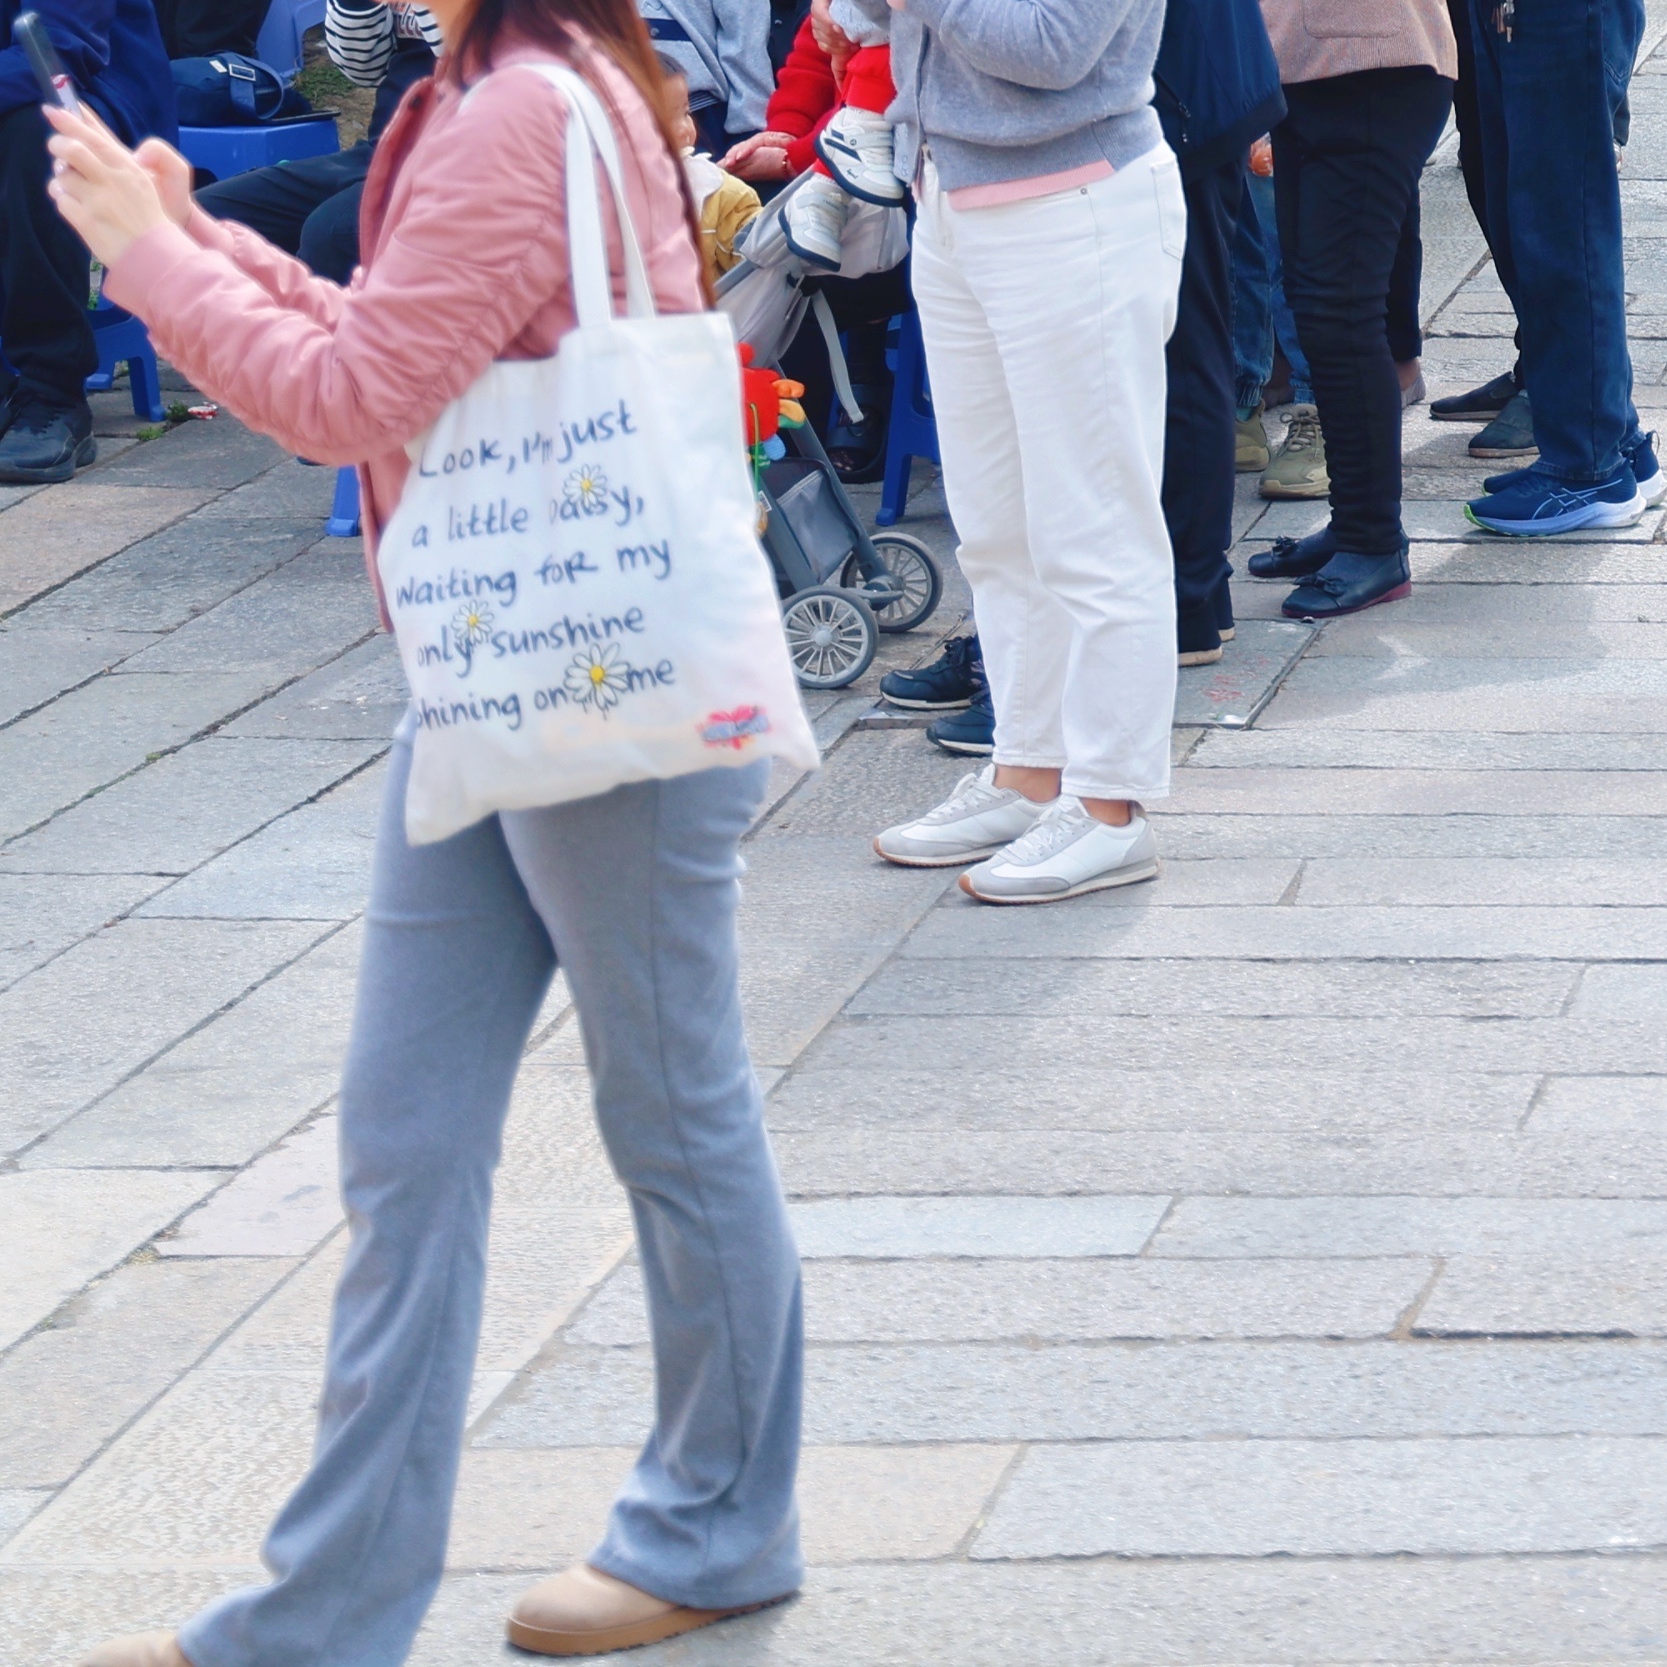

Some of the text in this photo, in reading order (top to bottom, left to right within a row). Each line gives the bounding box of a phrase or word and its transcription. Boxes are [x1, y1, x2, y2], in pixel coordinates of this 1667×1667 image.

[419, 438, 517, 477] Look,
[557, 399, 638, 463] just
[411, 524, 429, 549] a
[447, 497, 530, 542] little
[616, 538, 673, 581] my
[416, 605, 645, 679] only sunshine
[533, 685, 569, 711] on
[626, 658, 676, 694] me
